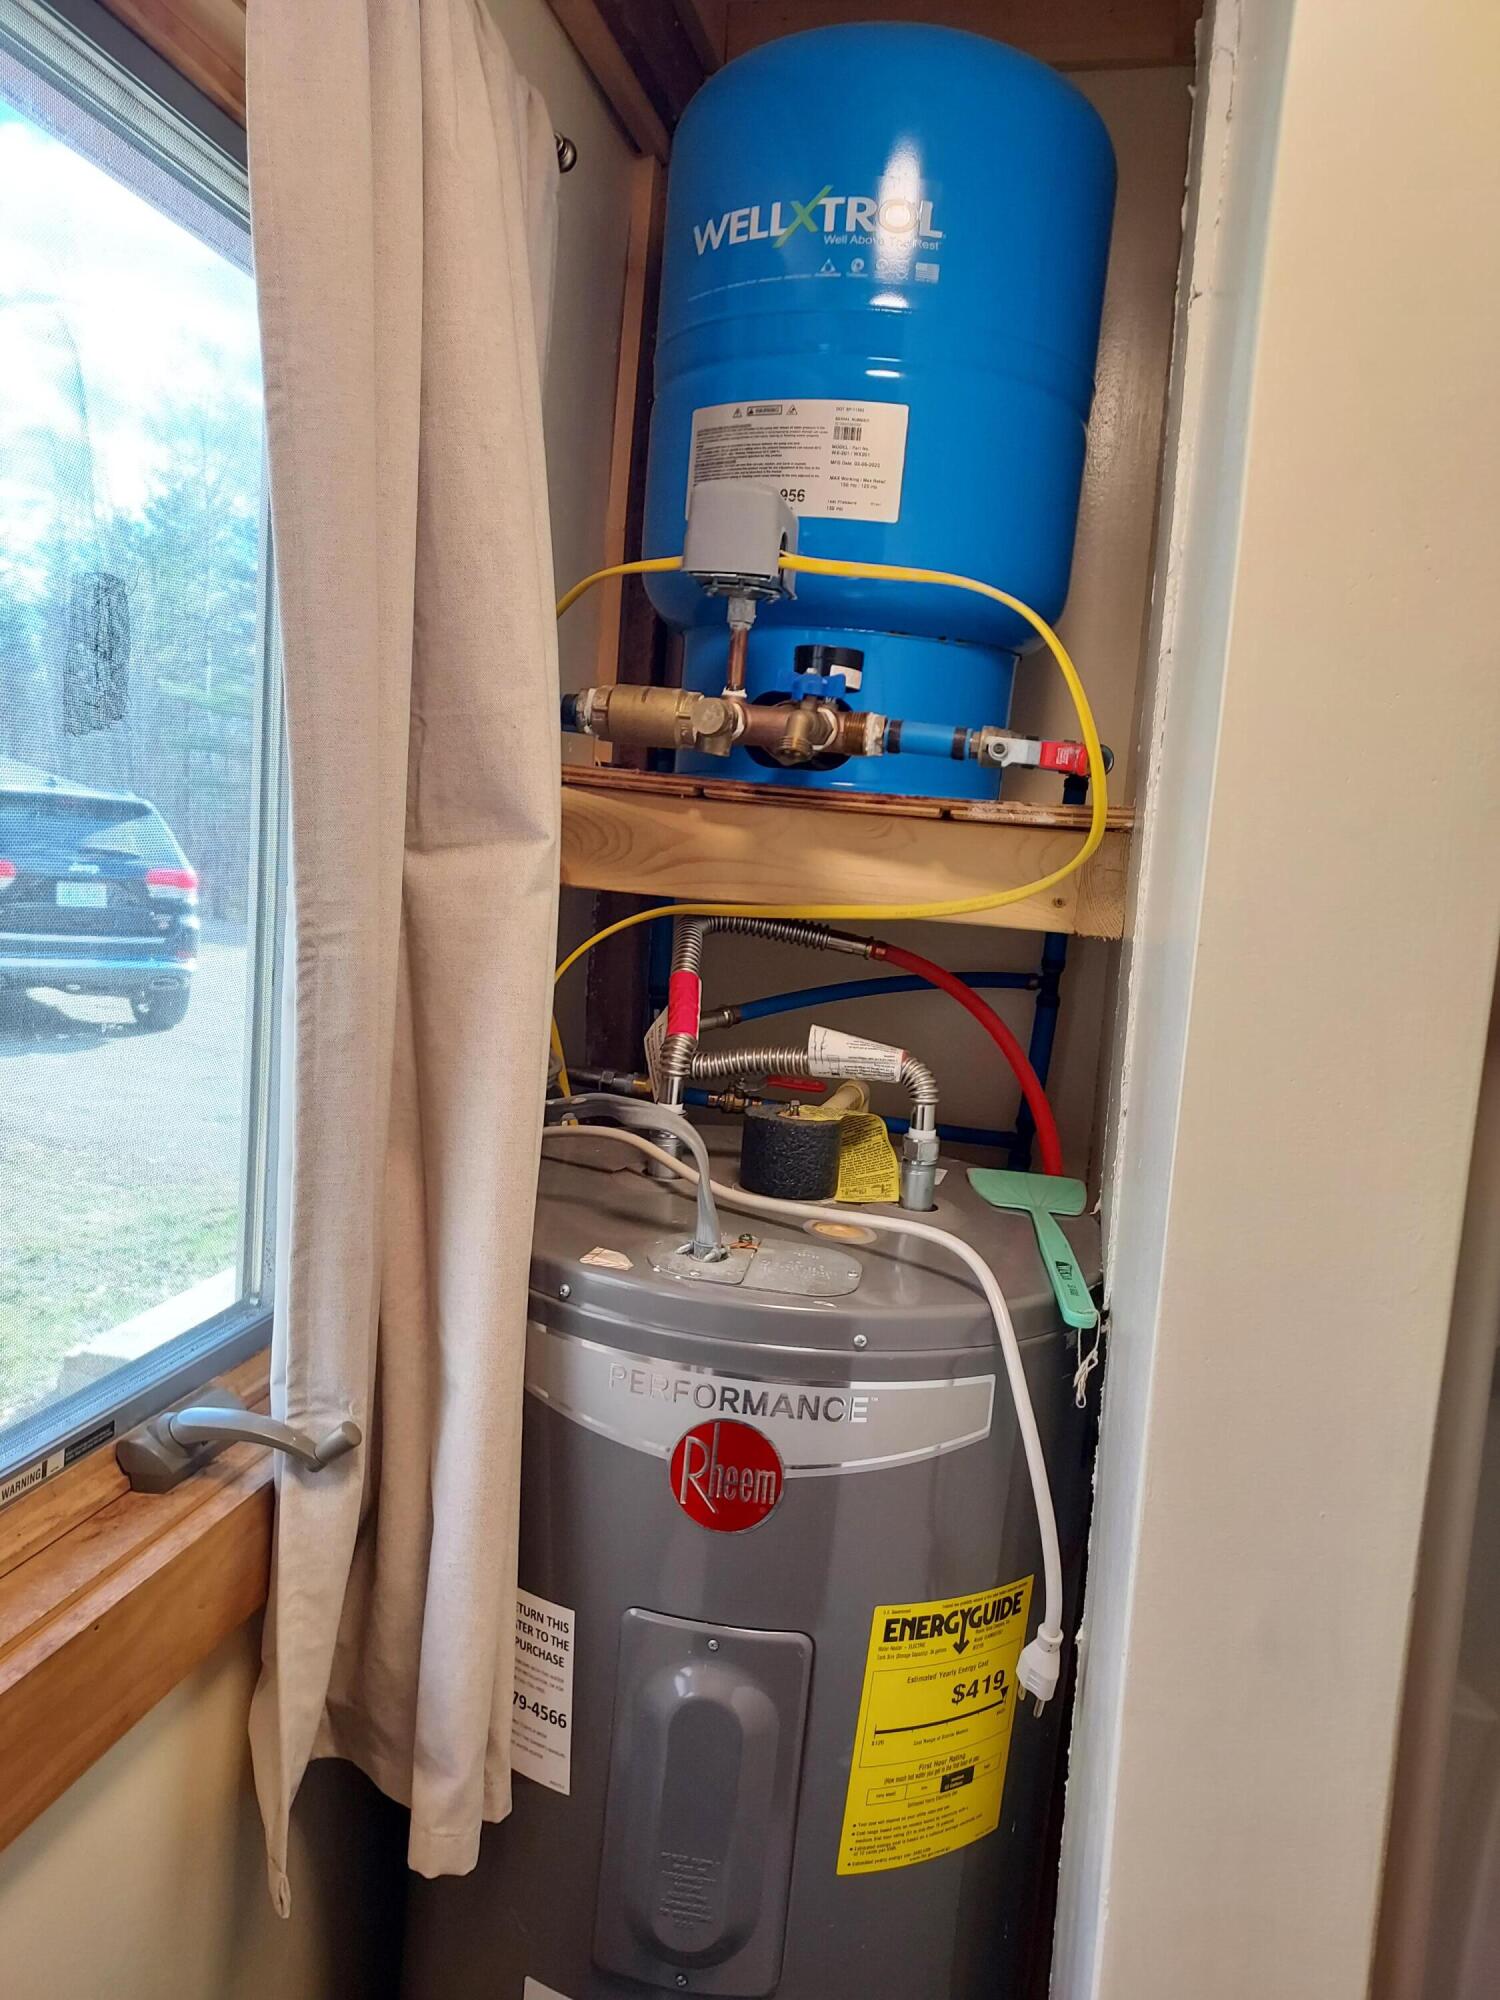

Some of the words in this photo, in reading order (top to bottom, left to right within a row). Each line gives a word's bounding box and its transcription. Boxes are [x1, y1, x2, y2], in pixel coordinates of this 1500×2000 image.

[693, 185, 943, 256] WELLXTROL
[824, 234, 848, 245] Well
[780, 488, 806, 502] 956
[608, 1362, 868, 1423] PERFORMANCE
[1, 1468, 41, 1500] WARNING
[679, 1422, 776, 1514] Rheem
[516, 1619, 534, 1637] TER
[535, 1628, 548, 1642] TO
[551, 1635, 570, 1652] THE
[546, 1615, 570, 1634] THIS
[883, 1590, 1024, 1647] ENERGYGUIDE
[958, 1663, 976, 1675] Energy
[952, 1670, 1005, 1706] $419
[512, 1691, 567, 1728] 79-4566
